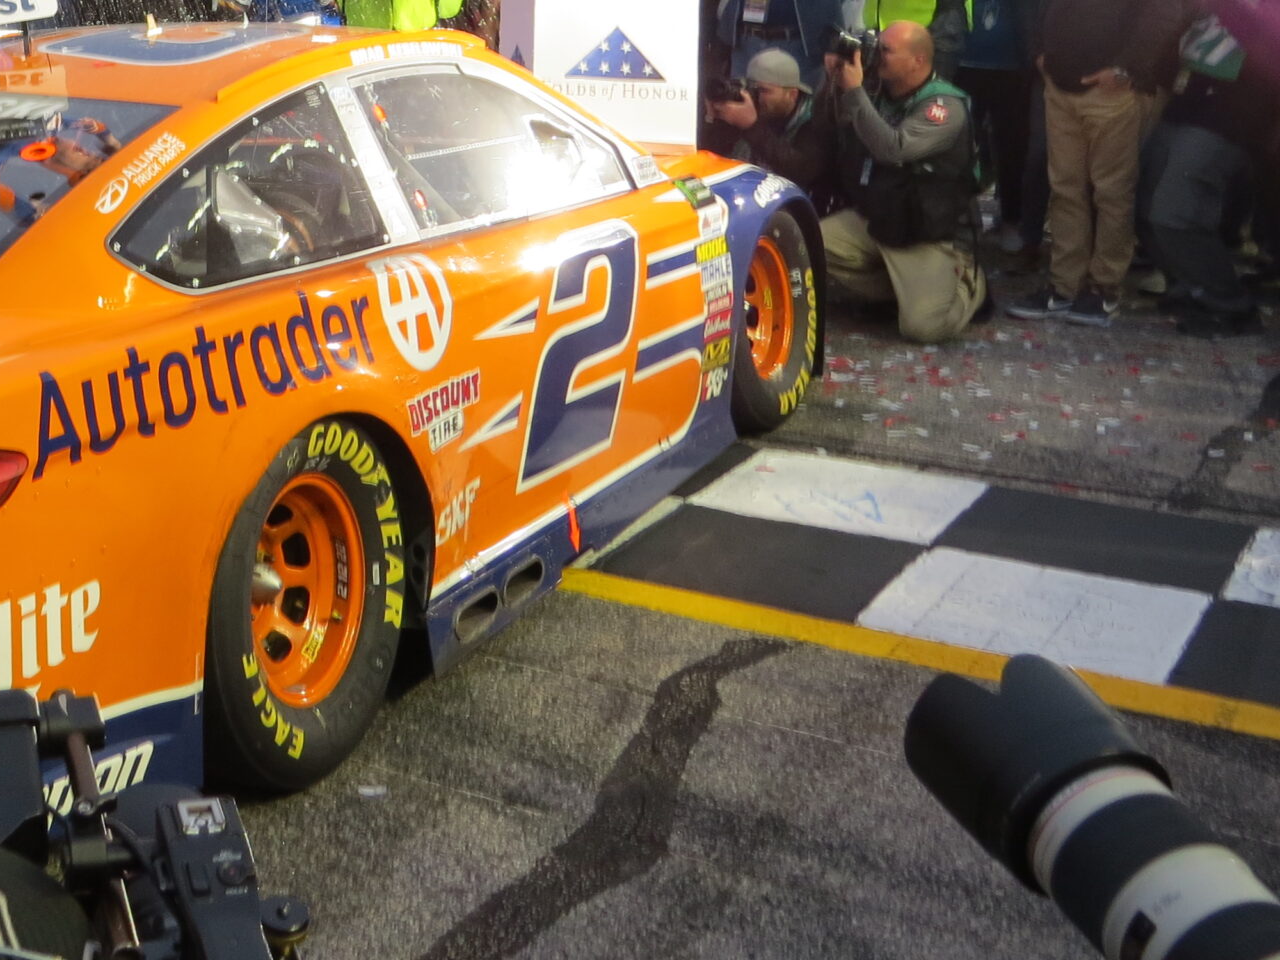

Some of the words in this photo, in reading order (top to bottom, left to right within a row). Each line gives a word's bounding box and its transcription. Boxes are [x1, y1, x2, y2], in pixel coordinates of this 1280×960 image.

[622, 83, 689, 101] HONOR
[122, 131, 177, 180] ALLIANCE
[33, 289, 376, 481] Autotrader
[516, 218, 639, 496] 2
[407, 370, 481, 435] DISCOUNT
[430, 414, 460, 449] TIRE
[307, 421, 405, 630] GOODYEAR
[242, 651, 305, 760] EAGLE
